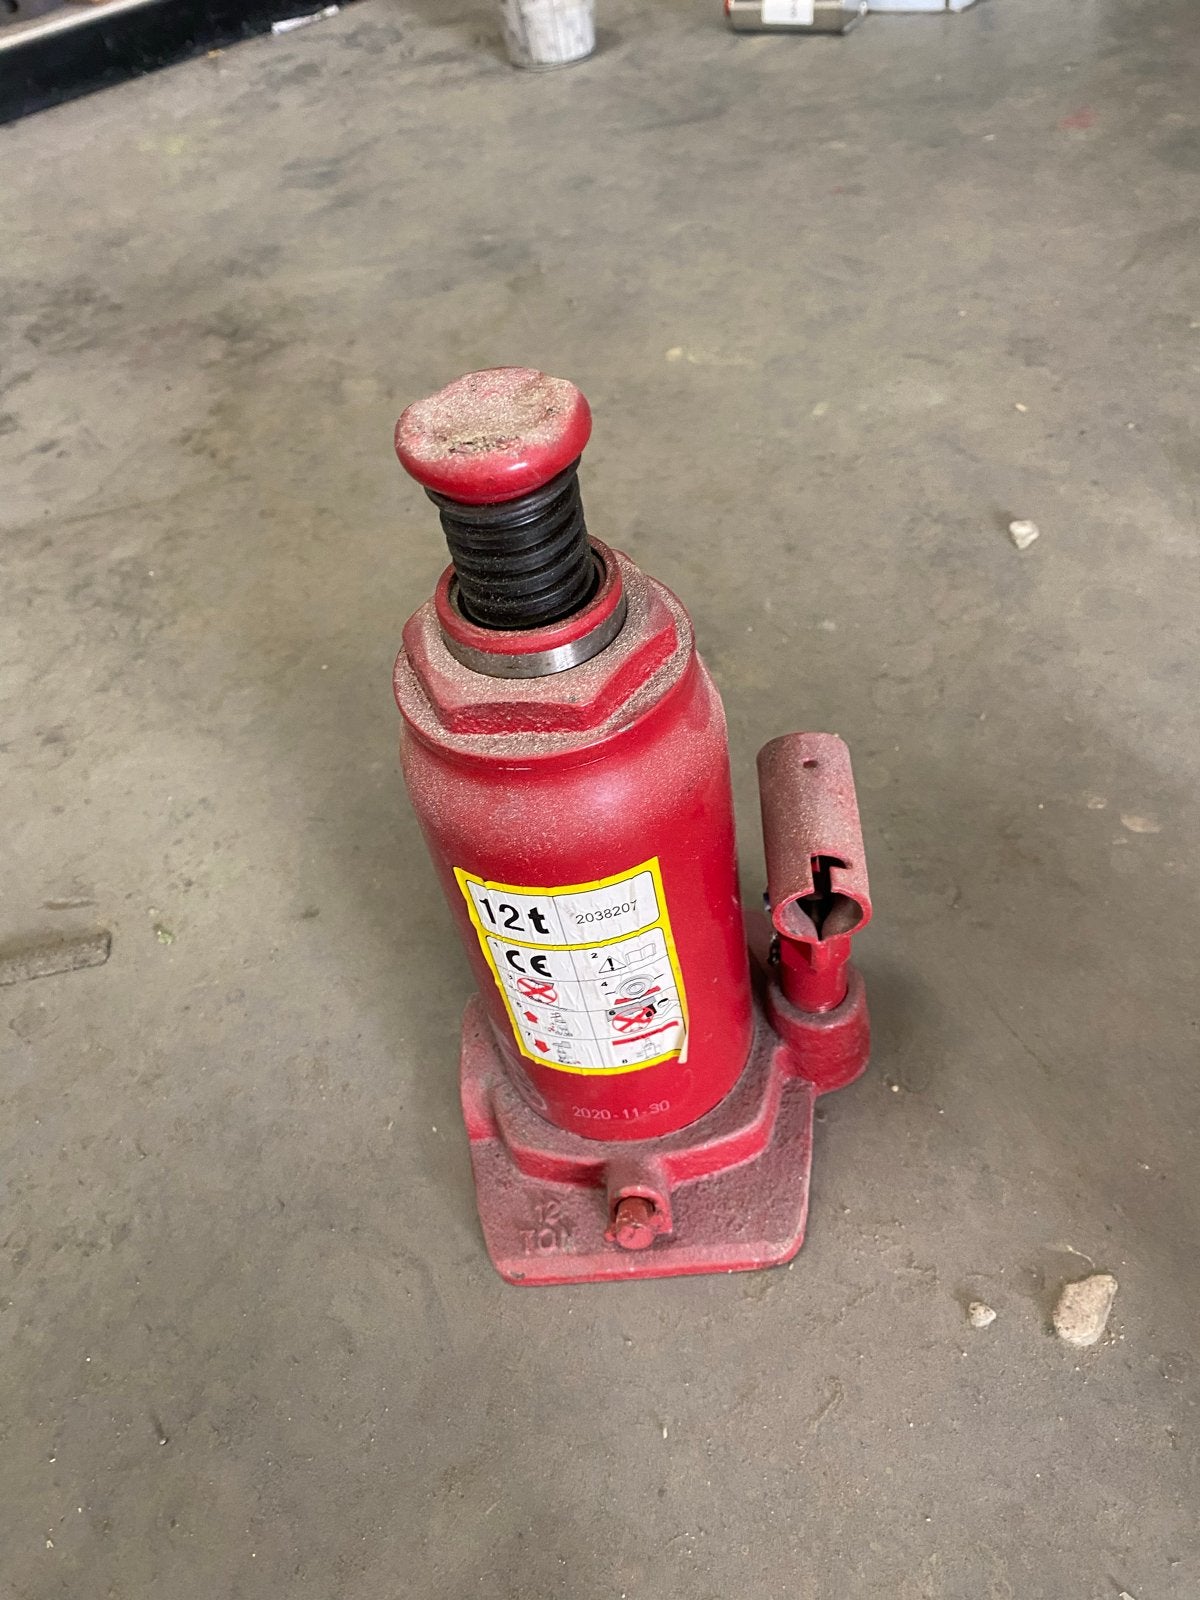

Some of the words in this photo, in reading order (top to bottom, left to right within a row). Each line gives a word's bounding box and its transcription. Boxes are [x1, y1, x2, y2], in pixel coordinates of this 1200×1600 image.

[479, 898, 549, 934] 12t
[575, 900, 638, 925] 2038207
[505, 949, 553, 978] CE
[572, 1099, 670, 1121] 2020-11-30
[535, 1200, 561, 1225] 12
[520, 1227, 577, 1256] TON
